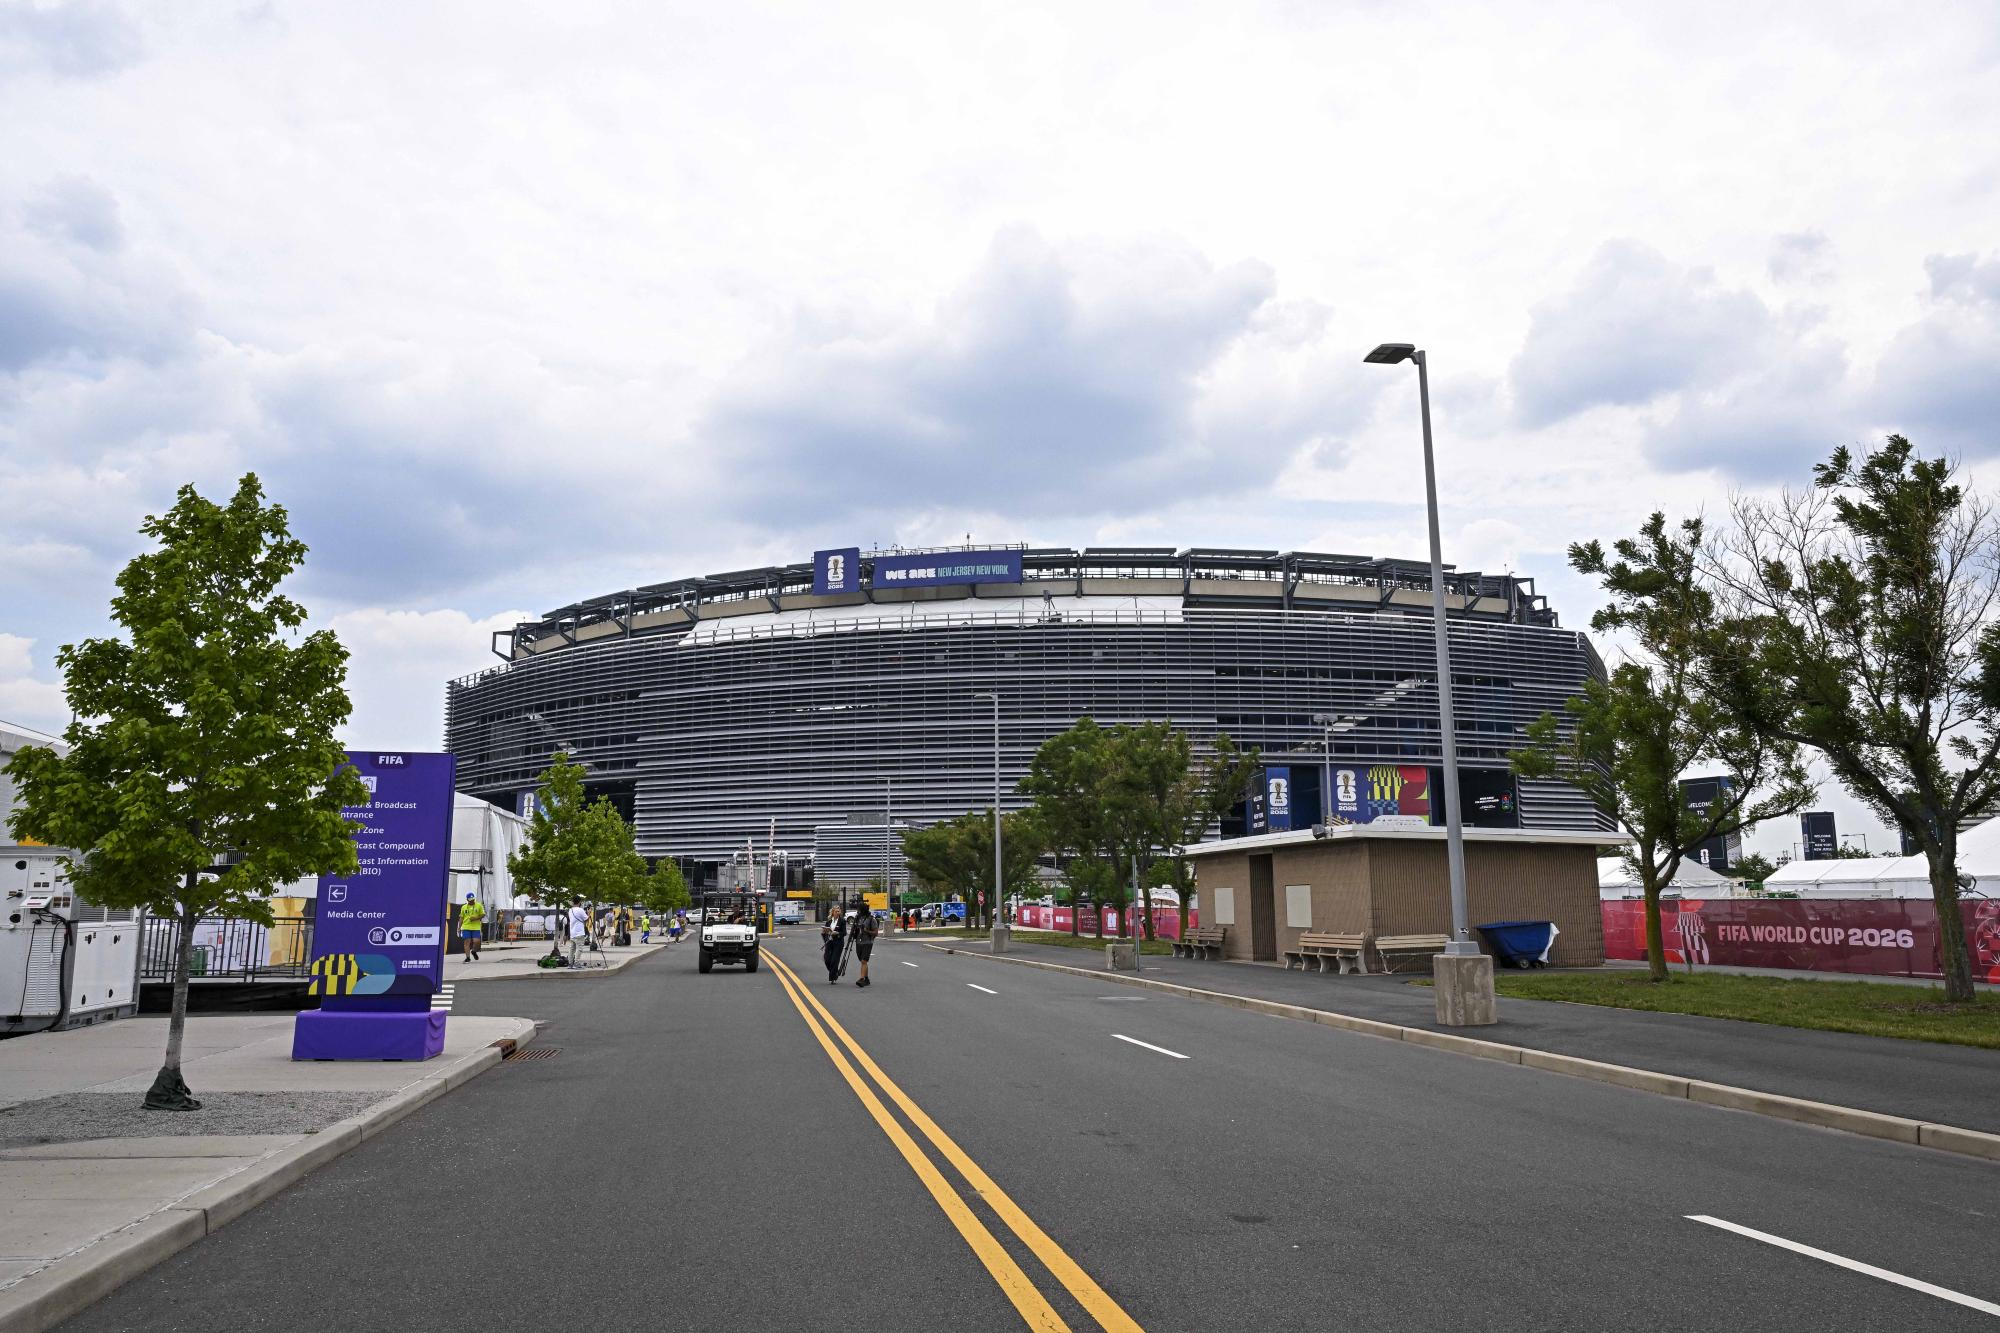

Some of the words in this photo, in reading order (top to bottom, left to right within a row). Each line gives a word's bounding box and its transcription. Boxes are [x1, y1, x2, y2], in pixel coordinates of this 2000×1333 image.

[938, 567, 952, 578] NEW
[952, 566, 975, 576] JERSEY
[976, 565, 990, 575] NEW
[992, 564, 1008, 574] YORK
[378, 756, 404, 764] FIFA
[378, 842, 425, 851] Compound
[360, 867, 382, 876] (BIO)
[1718, 925, 1749, 942] FIFA
[1750, 926, 1807, 943] WORLD
[1810, 927, 1845, 945] CUP
[1847, 928, 1914, 948] 2026
